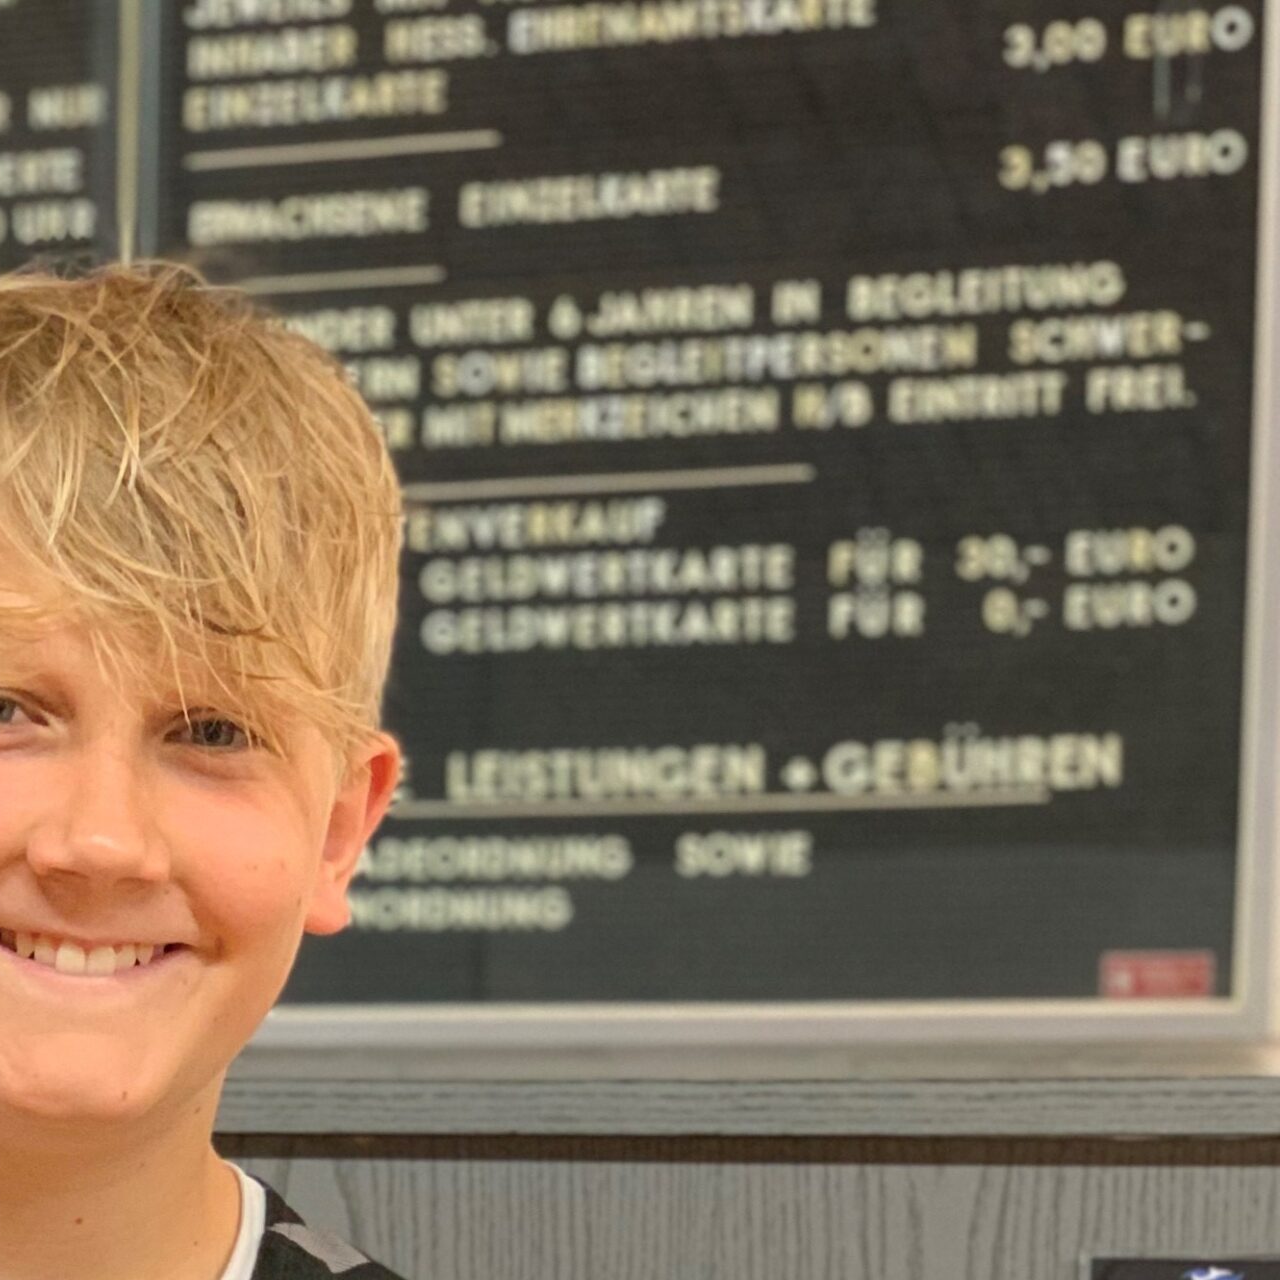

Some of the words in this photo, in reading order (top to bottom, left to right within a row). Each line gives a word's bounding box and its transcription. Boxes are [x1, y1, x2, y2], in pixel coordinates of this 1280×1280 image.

[1002, 19, 1106, 74] 3,00
[1122, 4, 1254, 61] EURO
[1115, 129, 1248, 184] EURO
[586, 282, 754, 337] JAHREN
[772, 278, 821, 324] IN
[847, 259, 1126, 322] BEGLEITUNG
[434, 345, 570, 396] SOWIE
[576, 319, 978, 389] BEGLEITPERSONEN
[888, 364, 1068, 422] EINTRITT
[406, 496, 664, 553] ENVERKAUF
[420, 543, 796, 603] GELDWERTKARTE
[827, 526, 923, 588] FÜR
[1064, 525, 1196, 577] EURO
[420, 597, 796, 654] GELDWERTKARTE
[827, 582, 924, 640] FÜR
[1063, 578, 1197, 632] EURO
[447, 746, 766, 804] LEISTUNGEN
[822, 723, 1126, 798] GEBÜHREN
[355, 834, 635, 882] ADEORDNUNG
[675, 832, 815, 879] SOWIE
